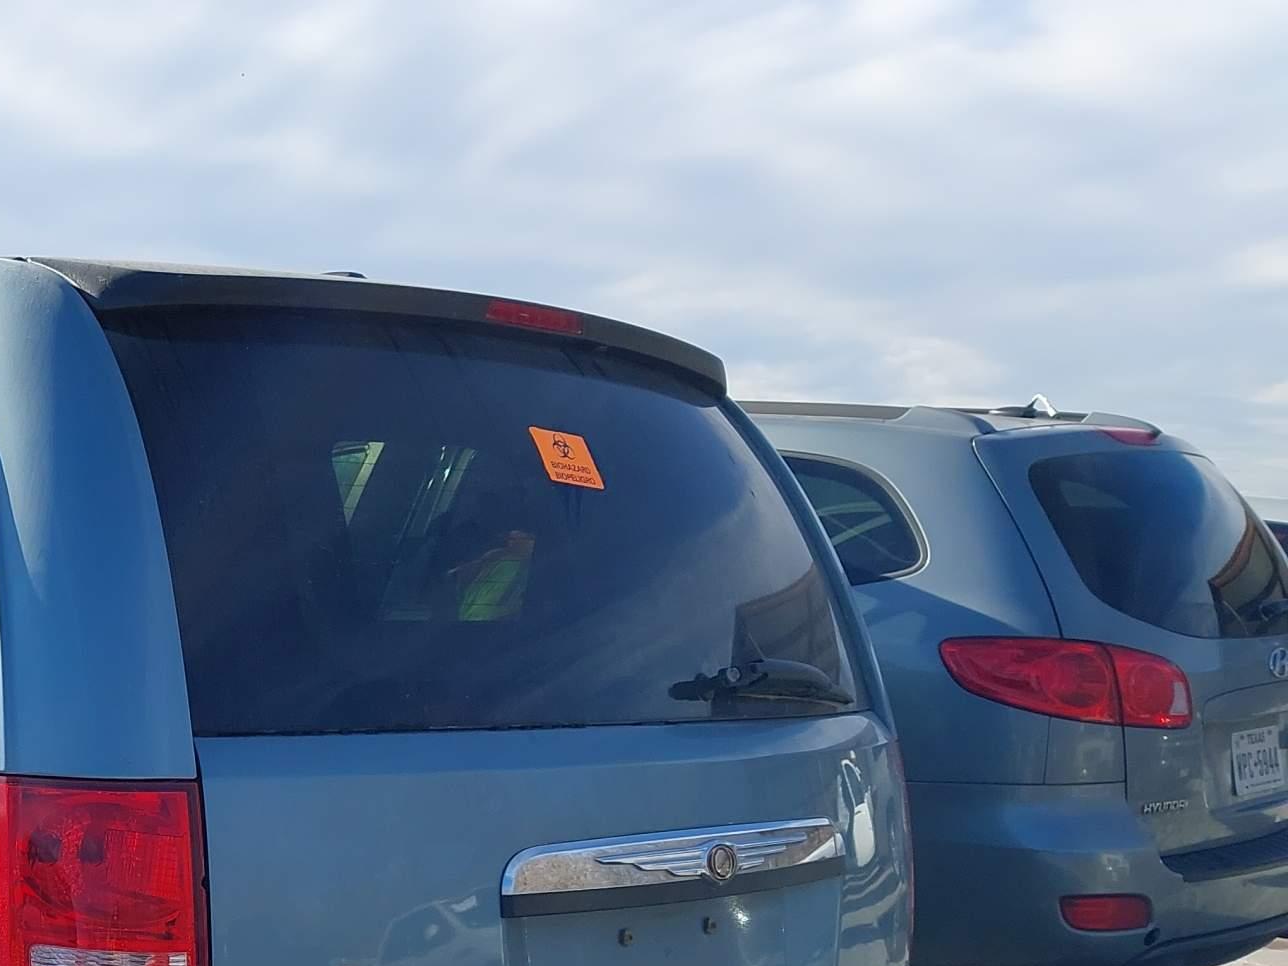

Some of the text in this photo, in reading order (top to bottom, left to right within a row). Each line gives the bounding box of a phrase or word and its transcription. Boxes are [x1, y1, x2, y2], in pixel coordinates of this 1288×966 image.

[551, 460, 591, 475] BIOHAZARD
[1248, 731, 1265, 744] TEXAS
[1143, 800, 1189, 814] HYUNDAI
